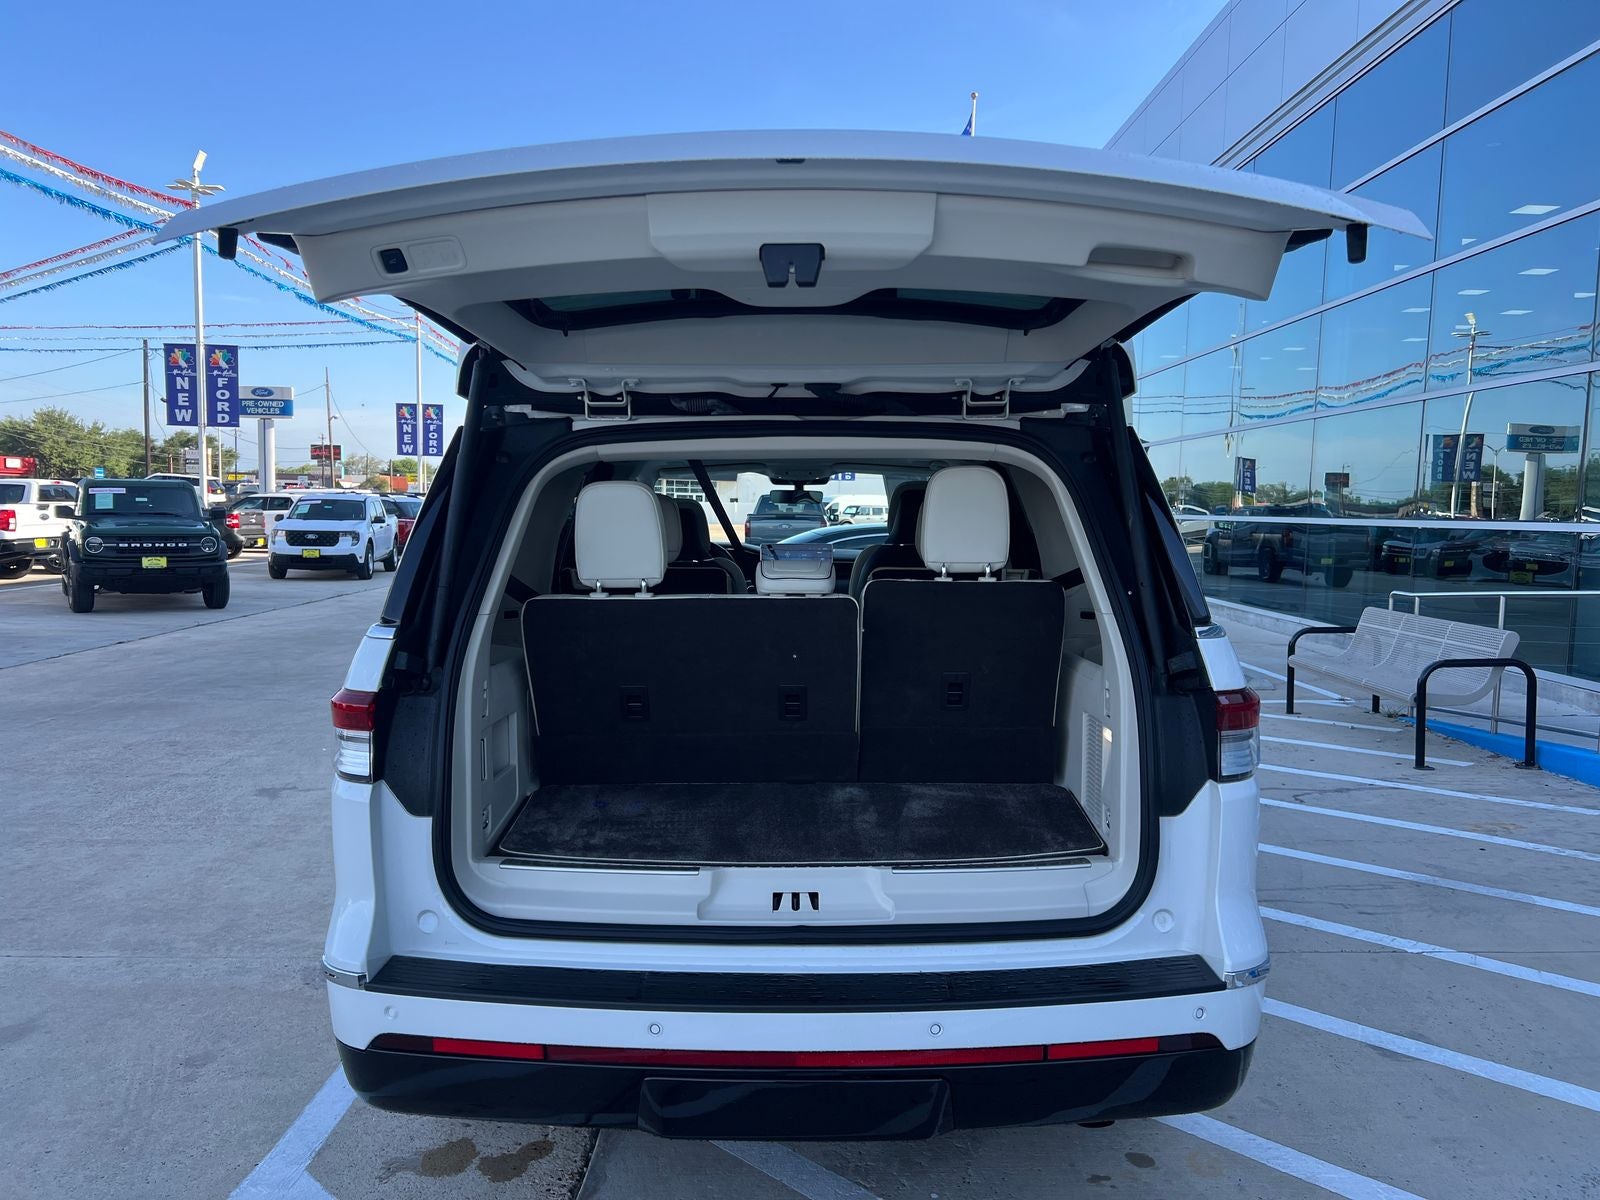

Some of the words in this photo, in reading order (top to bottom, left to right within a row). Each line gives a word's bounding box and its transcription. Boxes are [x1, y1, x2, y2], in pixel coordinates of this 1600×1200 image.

[175, 376, 192, 422] NEW
[216, 377, 230, 424] FORD
[246, 407, 280, 415] VEHICLES
[401, 424, 414, 454] NEW
[428, 424, 438, 454] FORD
